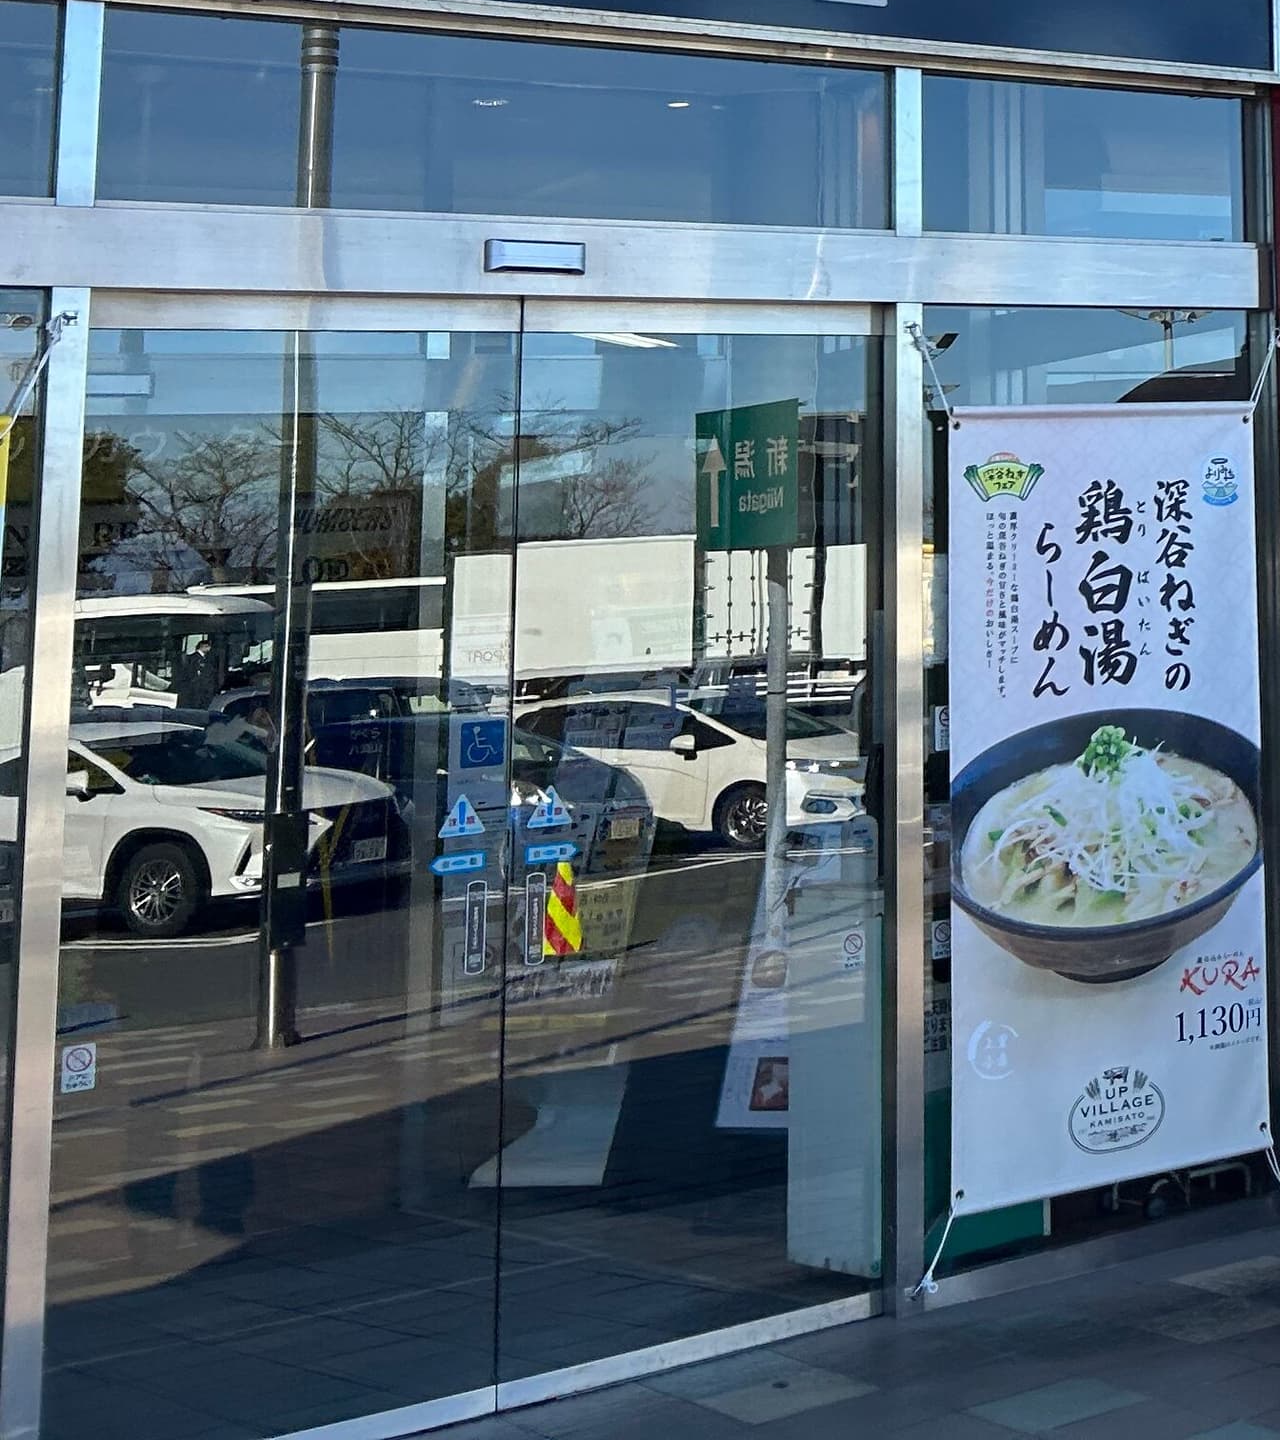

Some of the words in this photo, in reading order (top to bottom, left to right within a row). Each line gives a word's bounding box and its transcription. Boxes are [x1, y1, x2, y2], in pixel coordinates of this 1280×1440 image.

[1136, 499, 1147, 538] とり
[1075, 478, 1138, 688] 鶏白湯
[1153, 478, 1197, 692] 深谷ねぎの
[1031, 522, 1073, 700] らーめん
[1137, 569, 1153, 658] はいたん
[1180, 955, 1261, 996] KURA
[1175, 1002, 1262, 1045] 1,130円
[1080, 1093, 1155, 1119] VILLAGE
[1105, 1086, 1129, 1101] UP
[1089, 1111, 1145, 1130] KAMISATO
